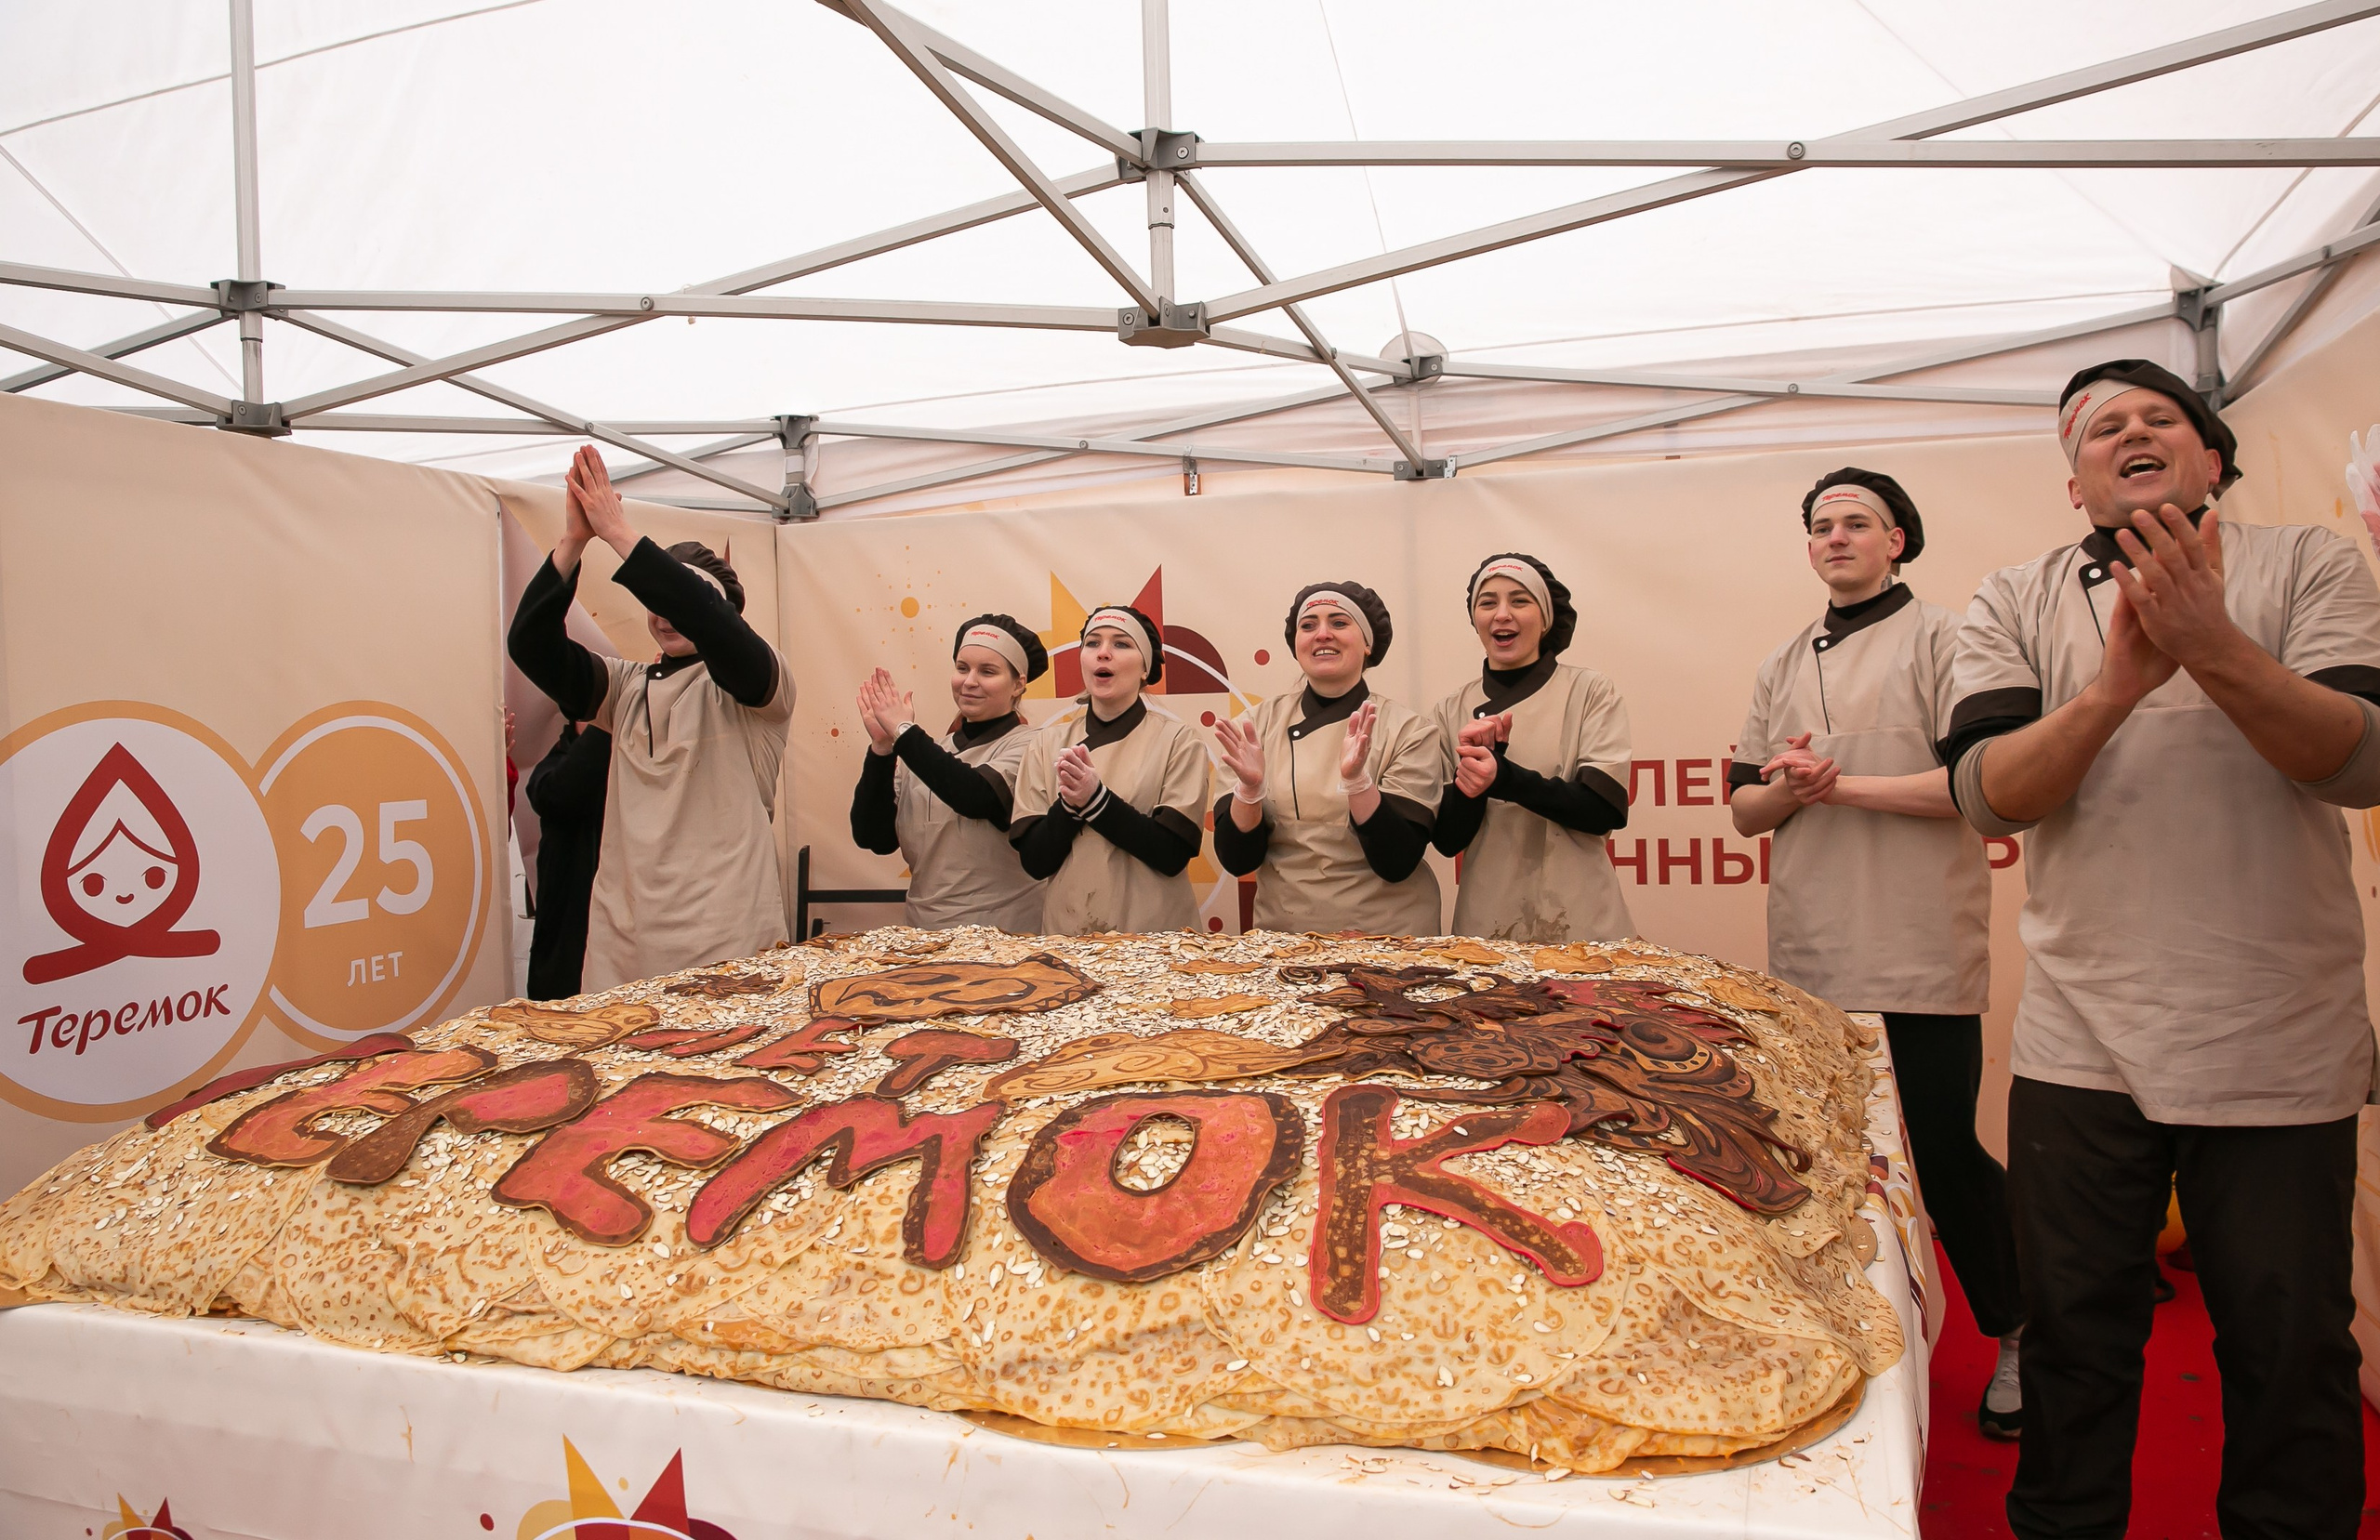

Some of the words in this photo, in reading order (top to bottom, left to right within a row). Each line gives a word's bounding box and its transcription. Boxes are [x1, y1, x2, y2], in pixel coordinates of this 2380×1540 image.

[299, 798, 435, 928] 25
[346, 951, 403, 986] ЛЕТ
[17, 983, 231, 1055] Теремок
